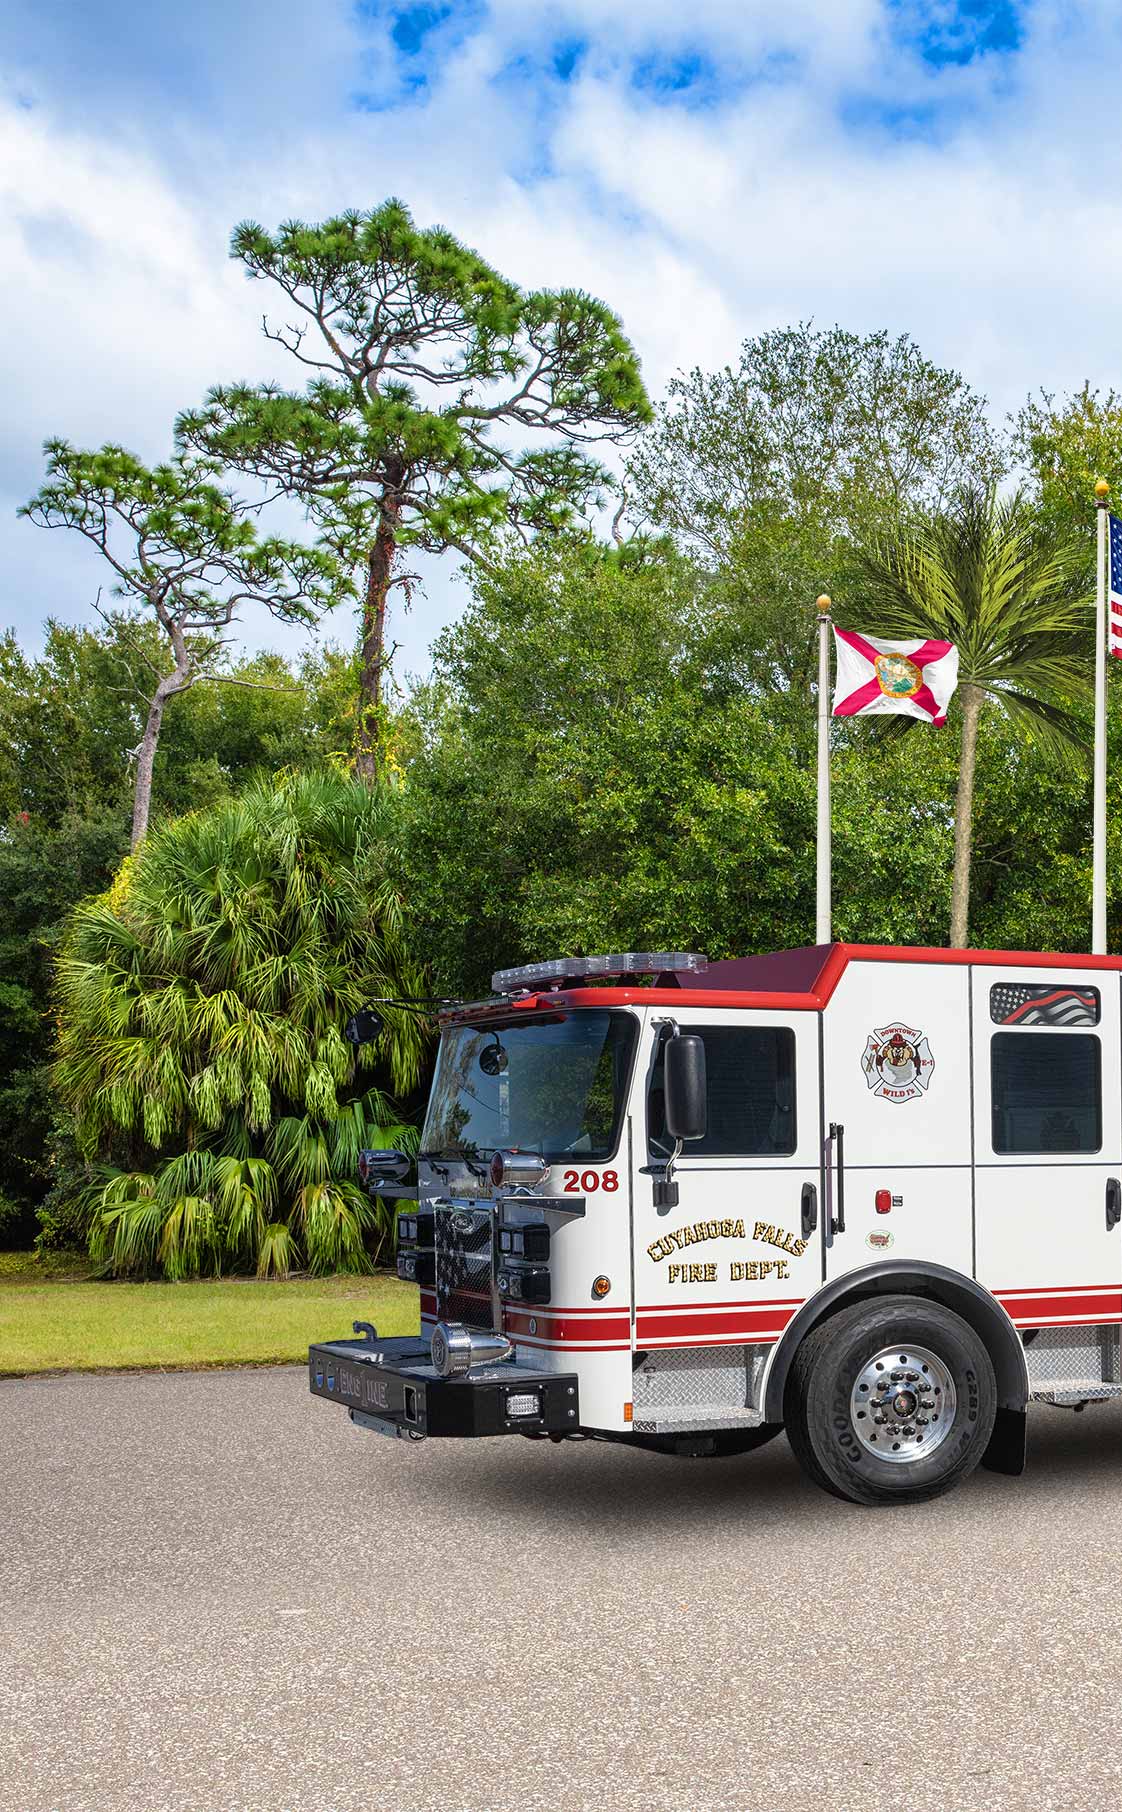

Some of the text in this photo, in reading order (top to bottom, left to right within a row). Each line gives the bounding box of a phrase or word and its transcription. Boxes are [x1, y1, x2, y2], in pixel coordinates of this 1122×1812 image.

[880, 1027, 917, 1038] DOWNTOWN
[882, 1087, 906, 1098] WILD
[563, 1170, 619, 1192] 208
[646, 1219, 809, 1262] CUYAHOGA FALLS
[668, 1260, 790, 1283] FIRE DEPT.
